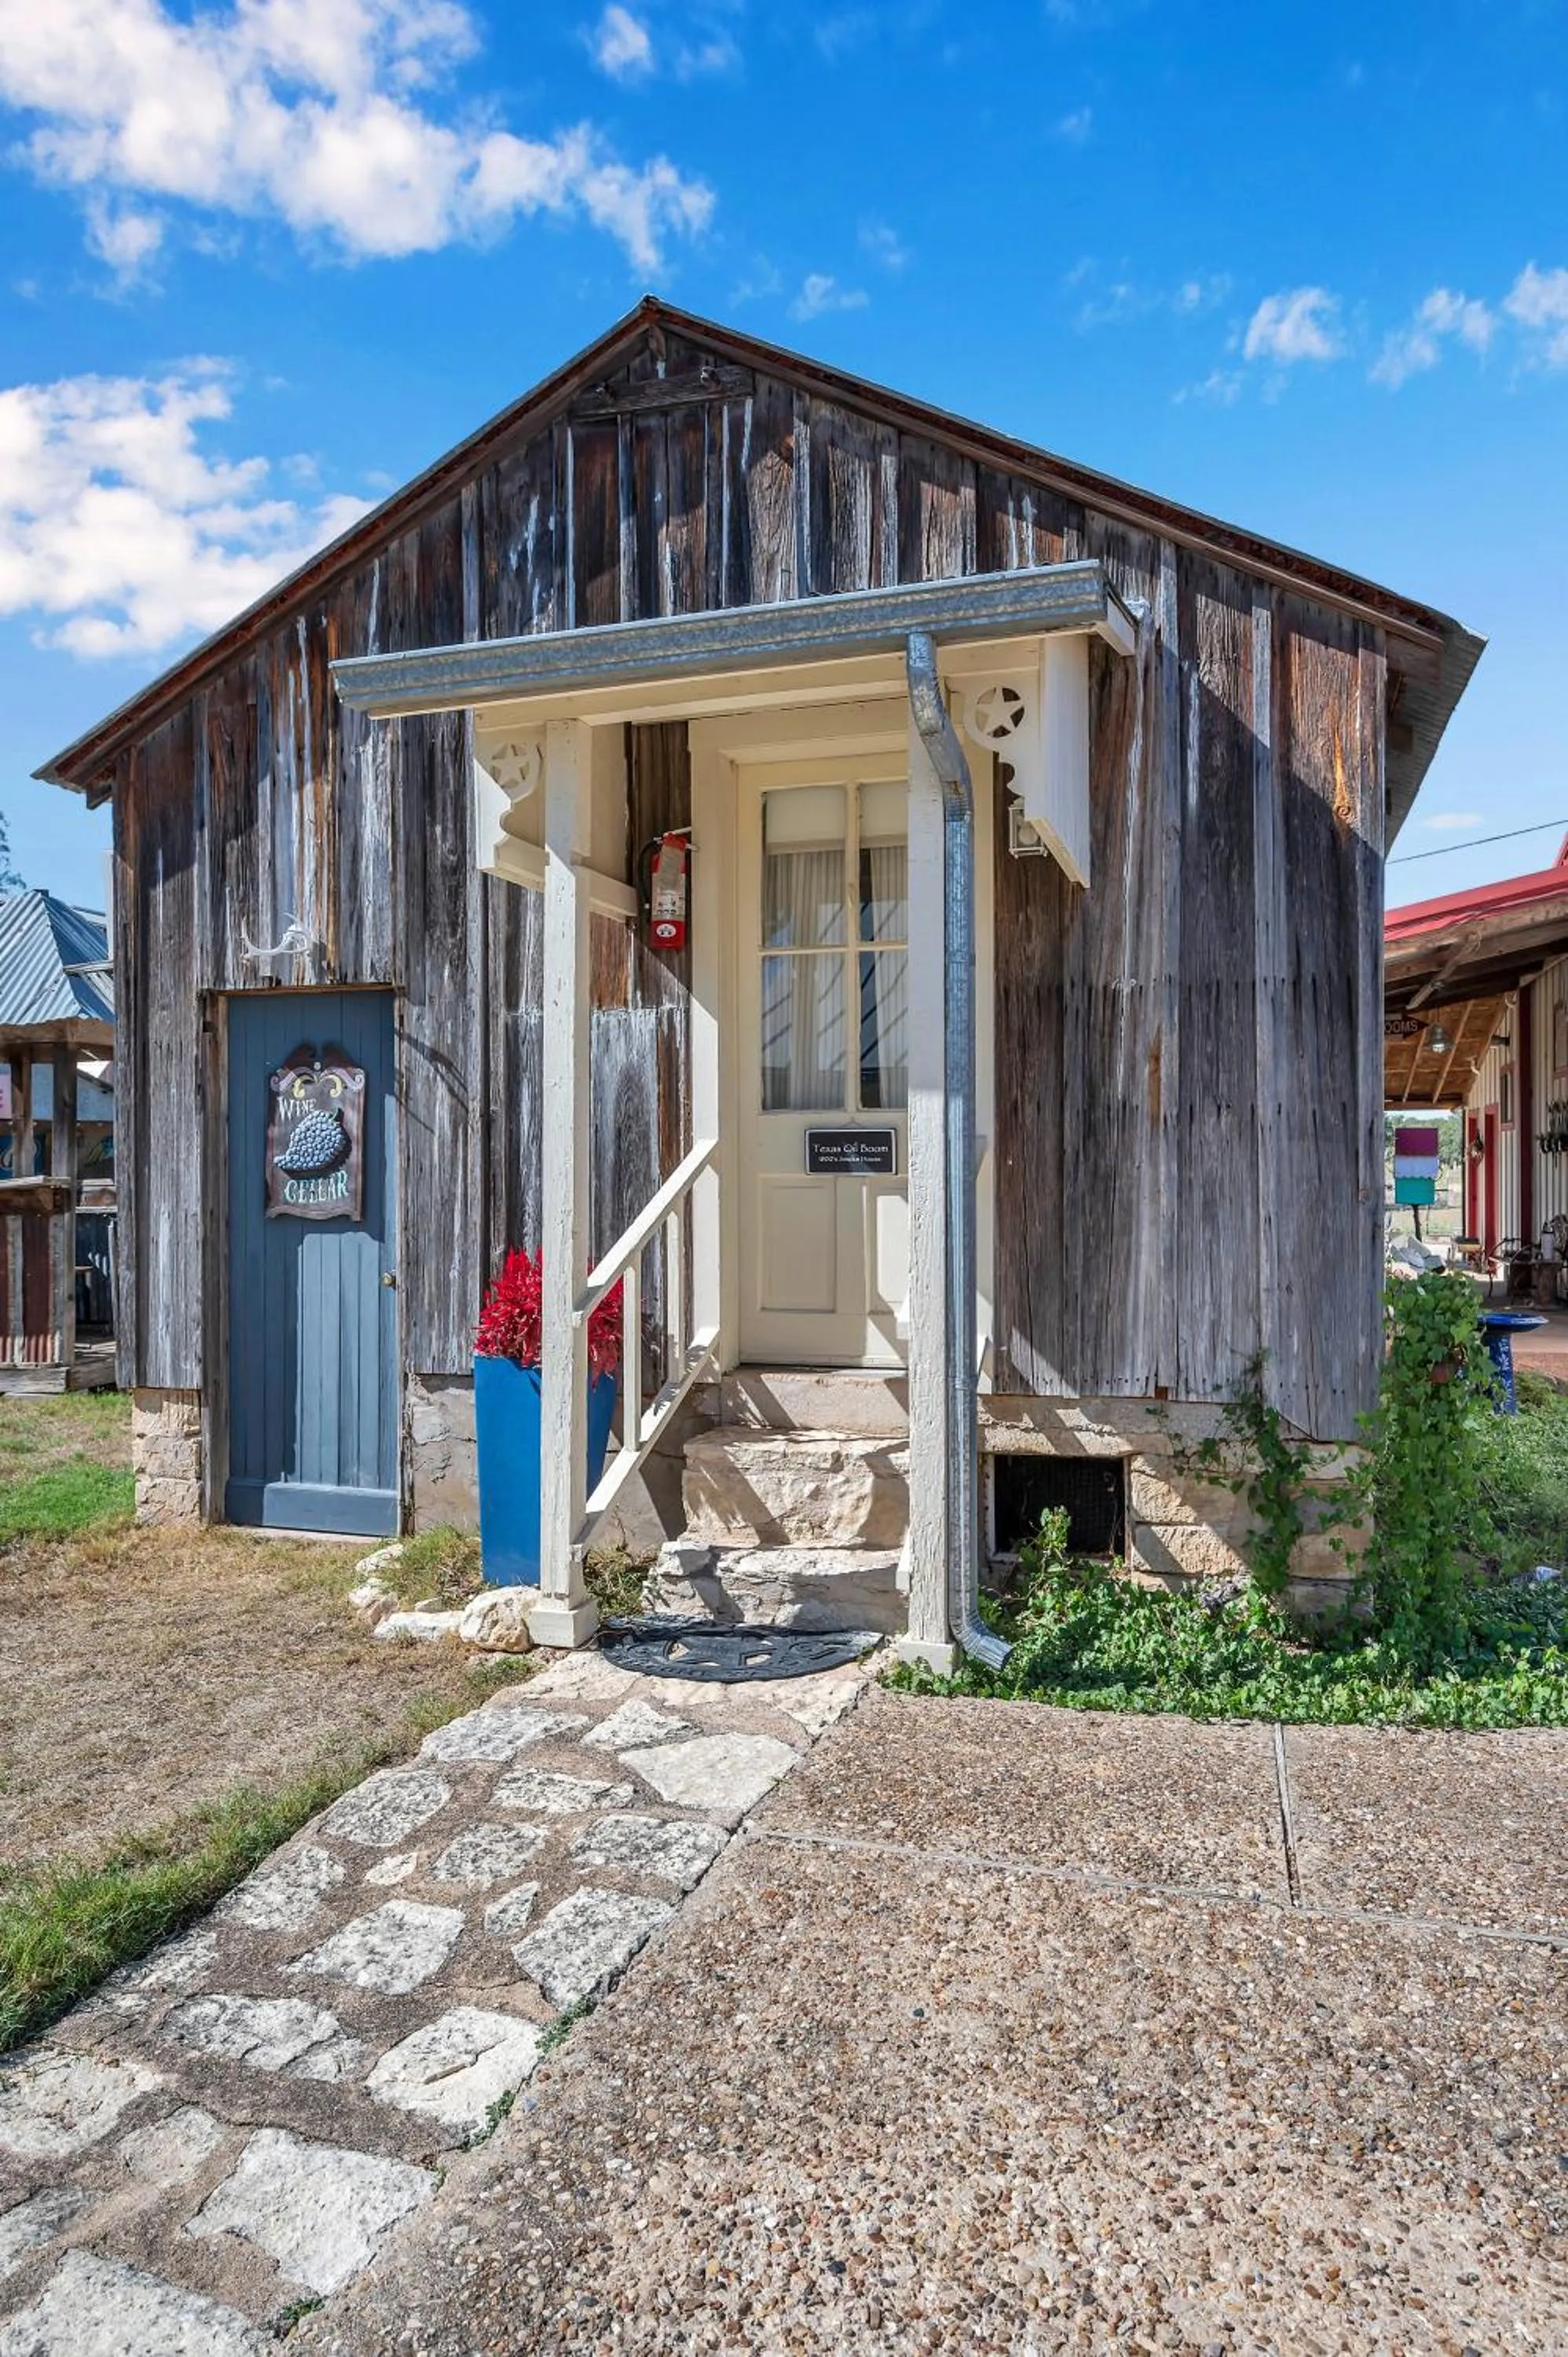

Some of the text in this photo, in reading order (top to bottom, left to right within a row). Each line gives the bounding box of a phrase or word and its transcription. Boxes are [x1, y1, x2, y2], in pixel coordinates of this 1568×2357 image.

[1385, 1021, 1418, 1033] OOMS
[277, 1096, 317, 1121] WINE
[284, 1170, 349, 1204] CELLAR
